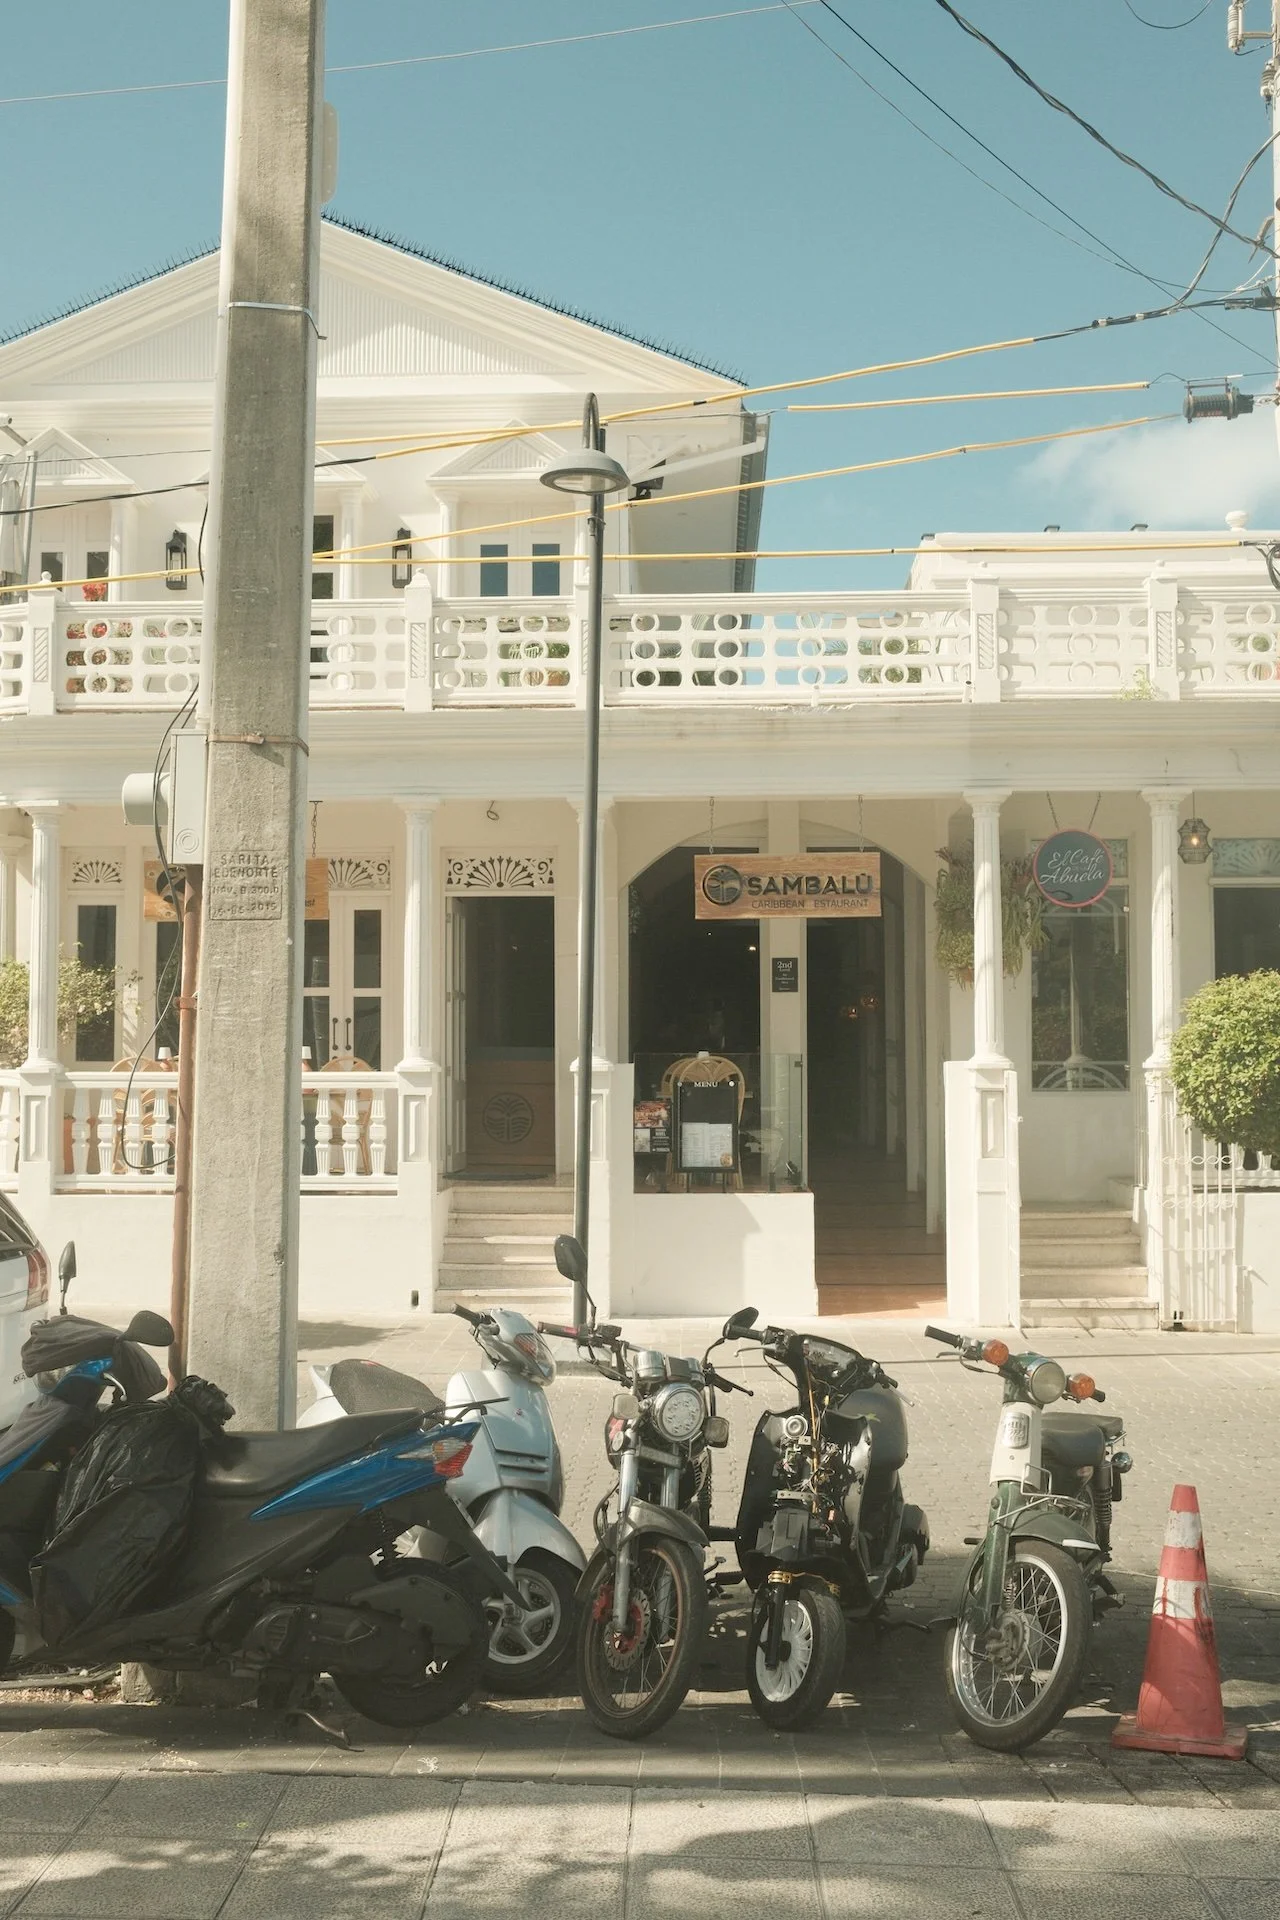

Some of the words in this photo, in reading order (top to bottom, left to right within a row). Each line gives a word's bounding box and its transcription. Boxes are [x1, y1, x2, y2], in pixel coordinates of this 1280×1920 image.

[220, 853, 269, 866] SARITA
[1047, 850, 1071, 869] El
[1070, 848, 1104, 871] Café
[1040, 863, 1104, 884] Abuela
[747, 873, 873, 896] SAMBALÚ
[751, 899, 805, 909] CARIBBEAN
